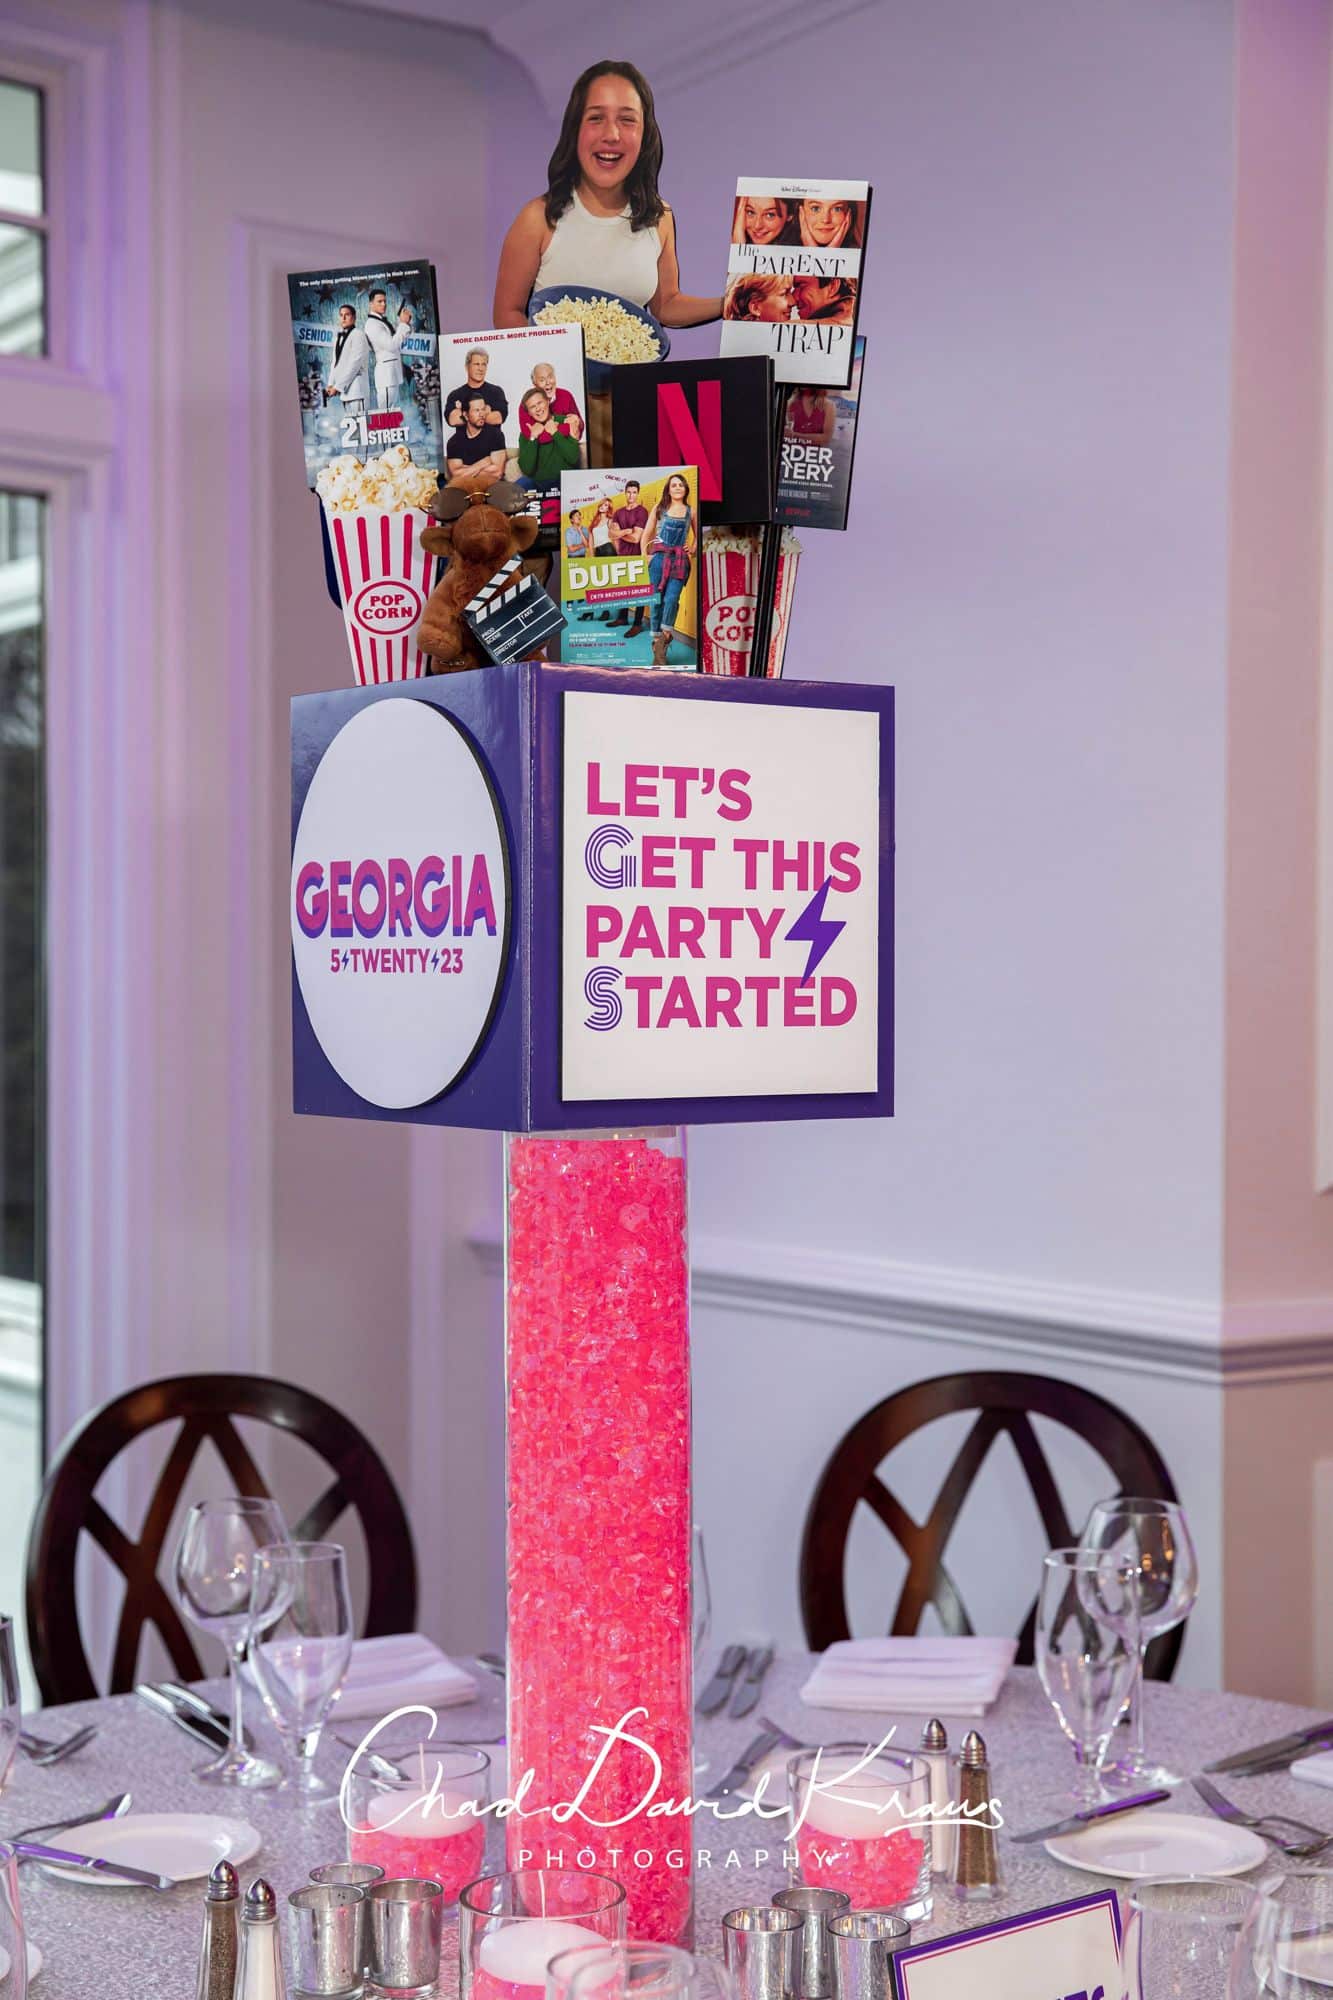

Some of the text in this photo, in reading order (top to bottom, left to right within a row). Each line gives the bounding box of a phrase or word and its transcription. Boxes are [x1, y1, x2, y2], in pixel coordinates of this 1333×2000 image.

[753, 254, 845, 276] PARENT
[299, 327, 333, 343] SENIOR
[528, 328, 568, 337] PROBLEMS.
[771, 322, 844, 354] TRAP
[401, 337, 431, 352] PROM
[341, 411, 404, 448] 21 JUMP
[369, 426, 410, 445] STREET
[781, 443, 833, 469] RDER
[781, 461, 835, 482] TERY
[568, 560, 644, 590] DUFF
[369, 594, 406, 607] POP
[361, 606, 413, 620] CORN
[521, 608, 534, 619] TAKE
[718, 606, 756, 623] PO
[494, 638, 518, 657] DIRECTOR
[587, 762, 752, 821] LET'S
[585, 824, 861, 893] GET THIS
[296, 854, 497, 939] GEORGIA
[586, 905, 786, 959] PARTY
[350, 948, 430, 973] TWENTY
[440, 948, 463, 974] 23
[584, 966, 857, 1031] STARTED
